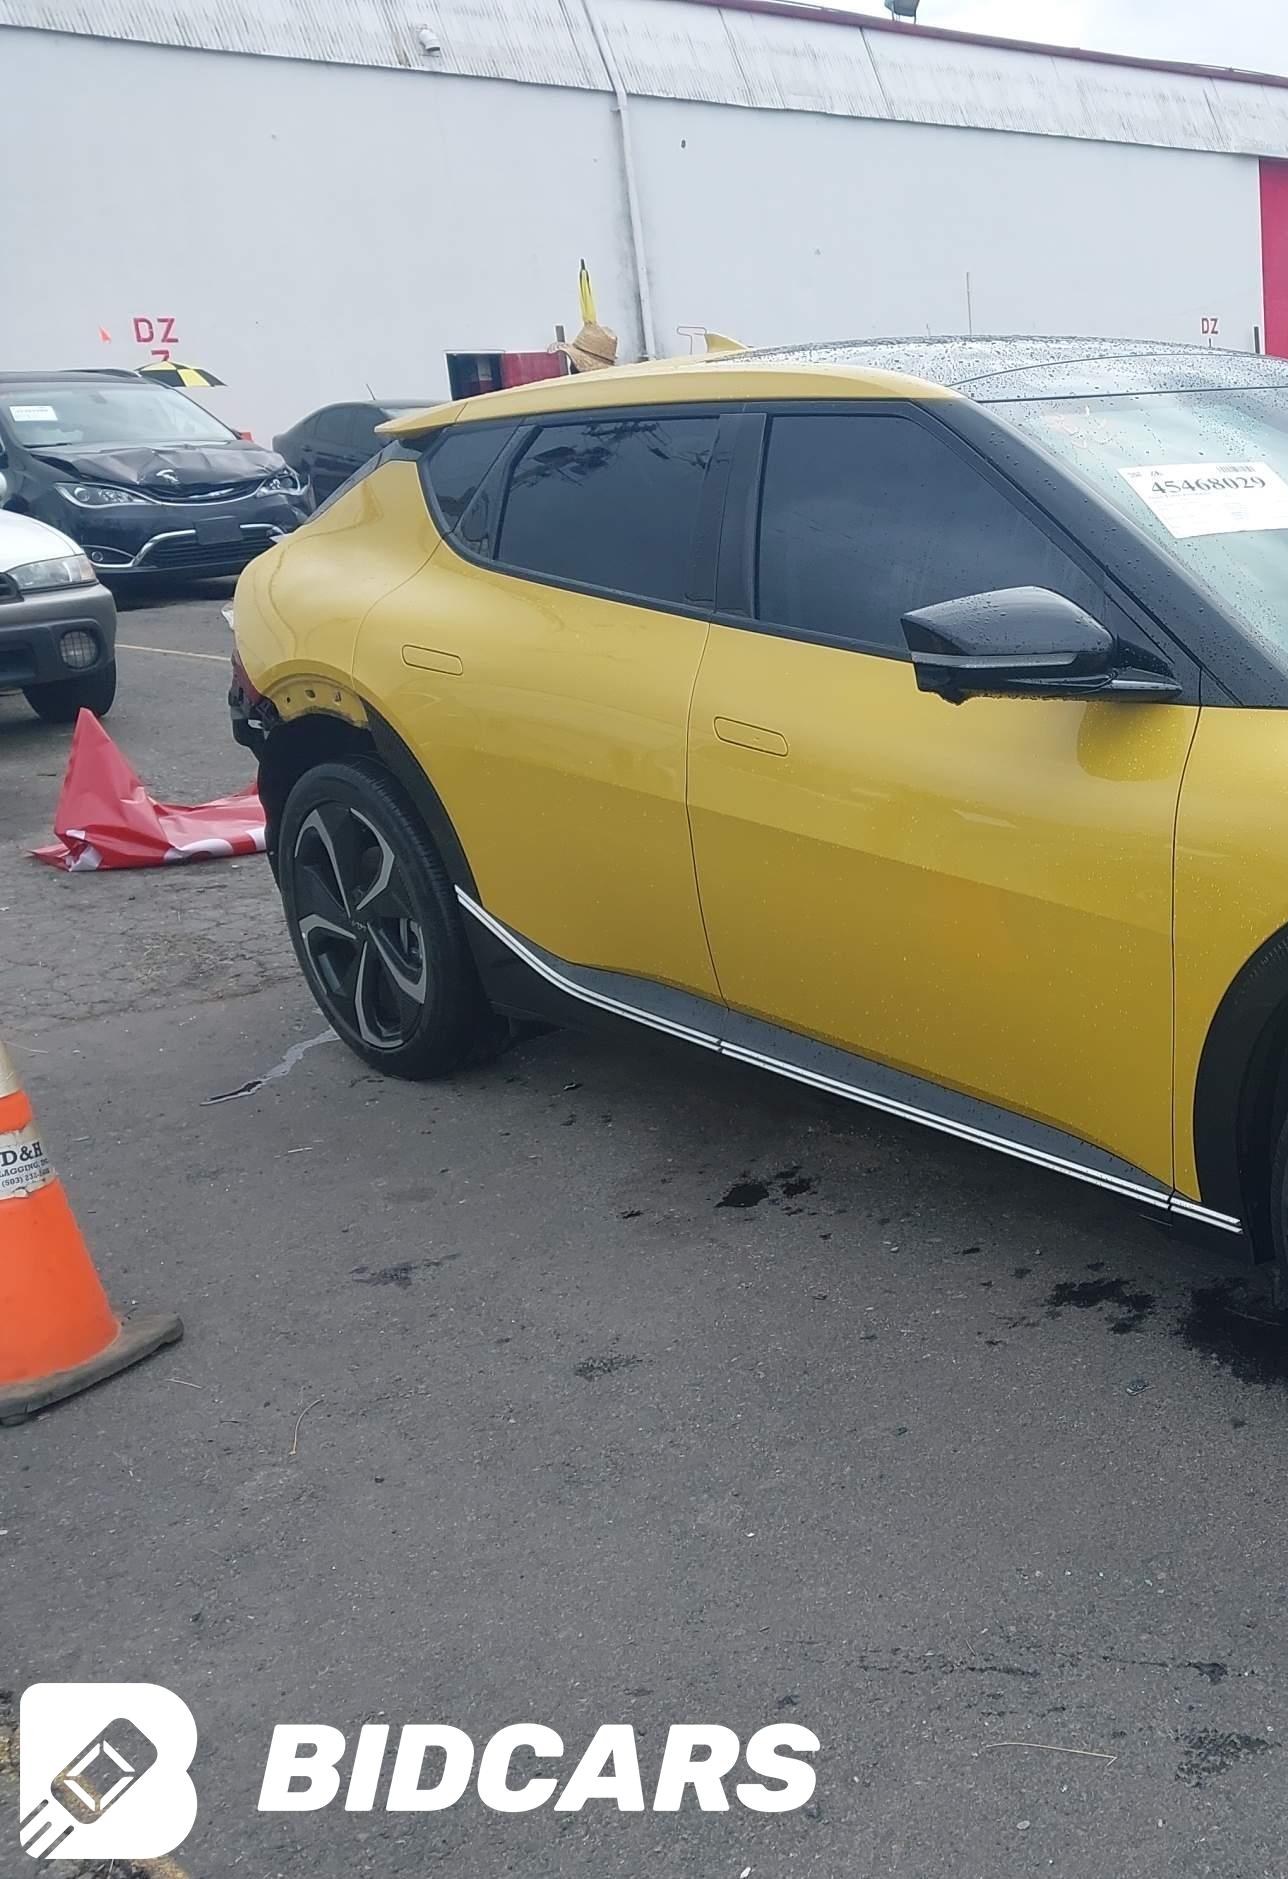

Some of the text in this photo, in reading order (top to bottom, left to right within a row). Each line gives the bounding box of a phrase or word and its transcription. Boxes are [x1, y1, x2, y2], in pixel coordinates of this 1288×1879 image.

[132, 317, 180, 343] DZ
[1201, 317, 1219, 335] DZ
[1151, 476, 1267, 494] 45468029
